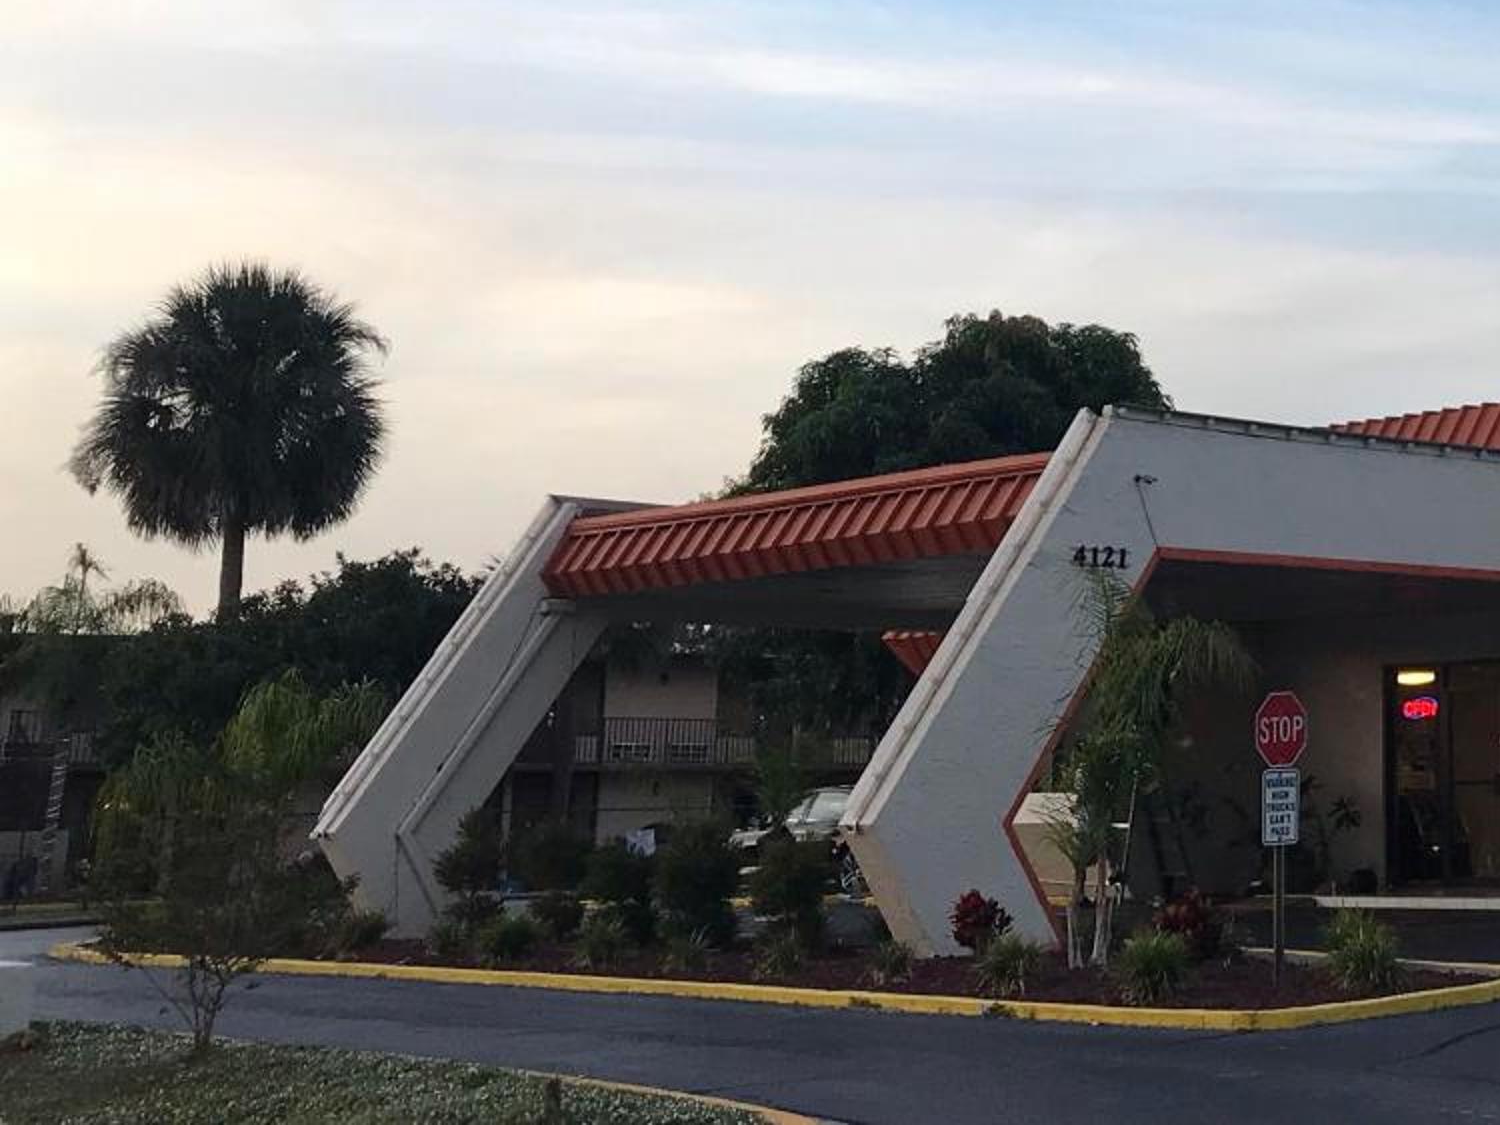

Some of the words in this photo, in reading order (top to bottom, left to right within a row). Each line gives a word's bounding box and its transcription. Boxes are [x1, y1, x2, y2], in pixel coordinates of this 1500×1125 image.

[1073, 545, 1127, 569] 4121
[1403, 698, 1437, 718] OPEN
[1259, 716, 1303, 744] STOP
